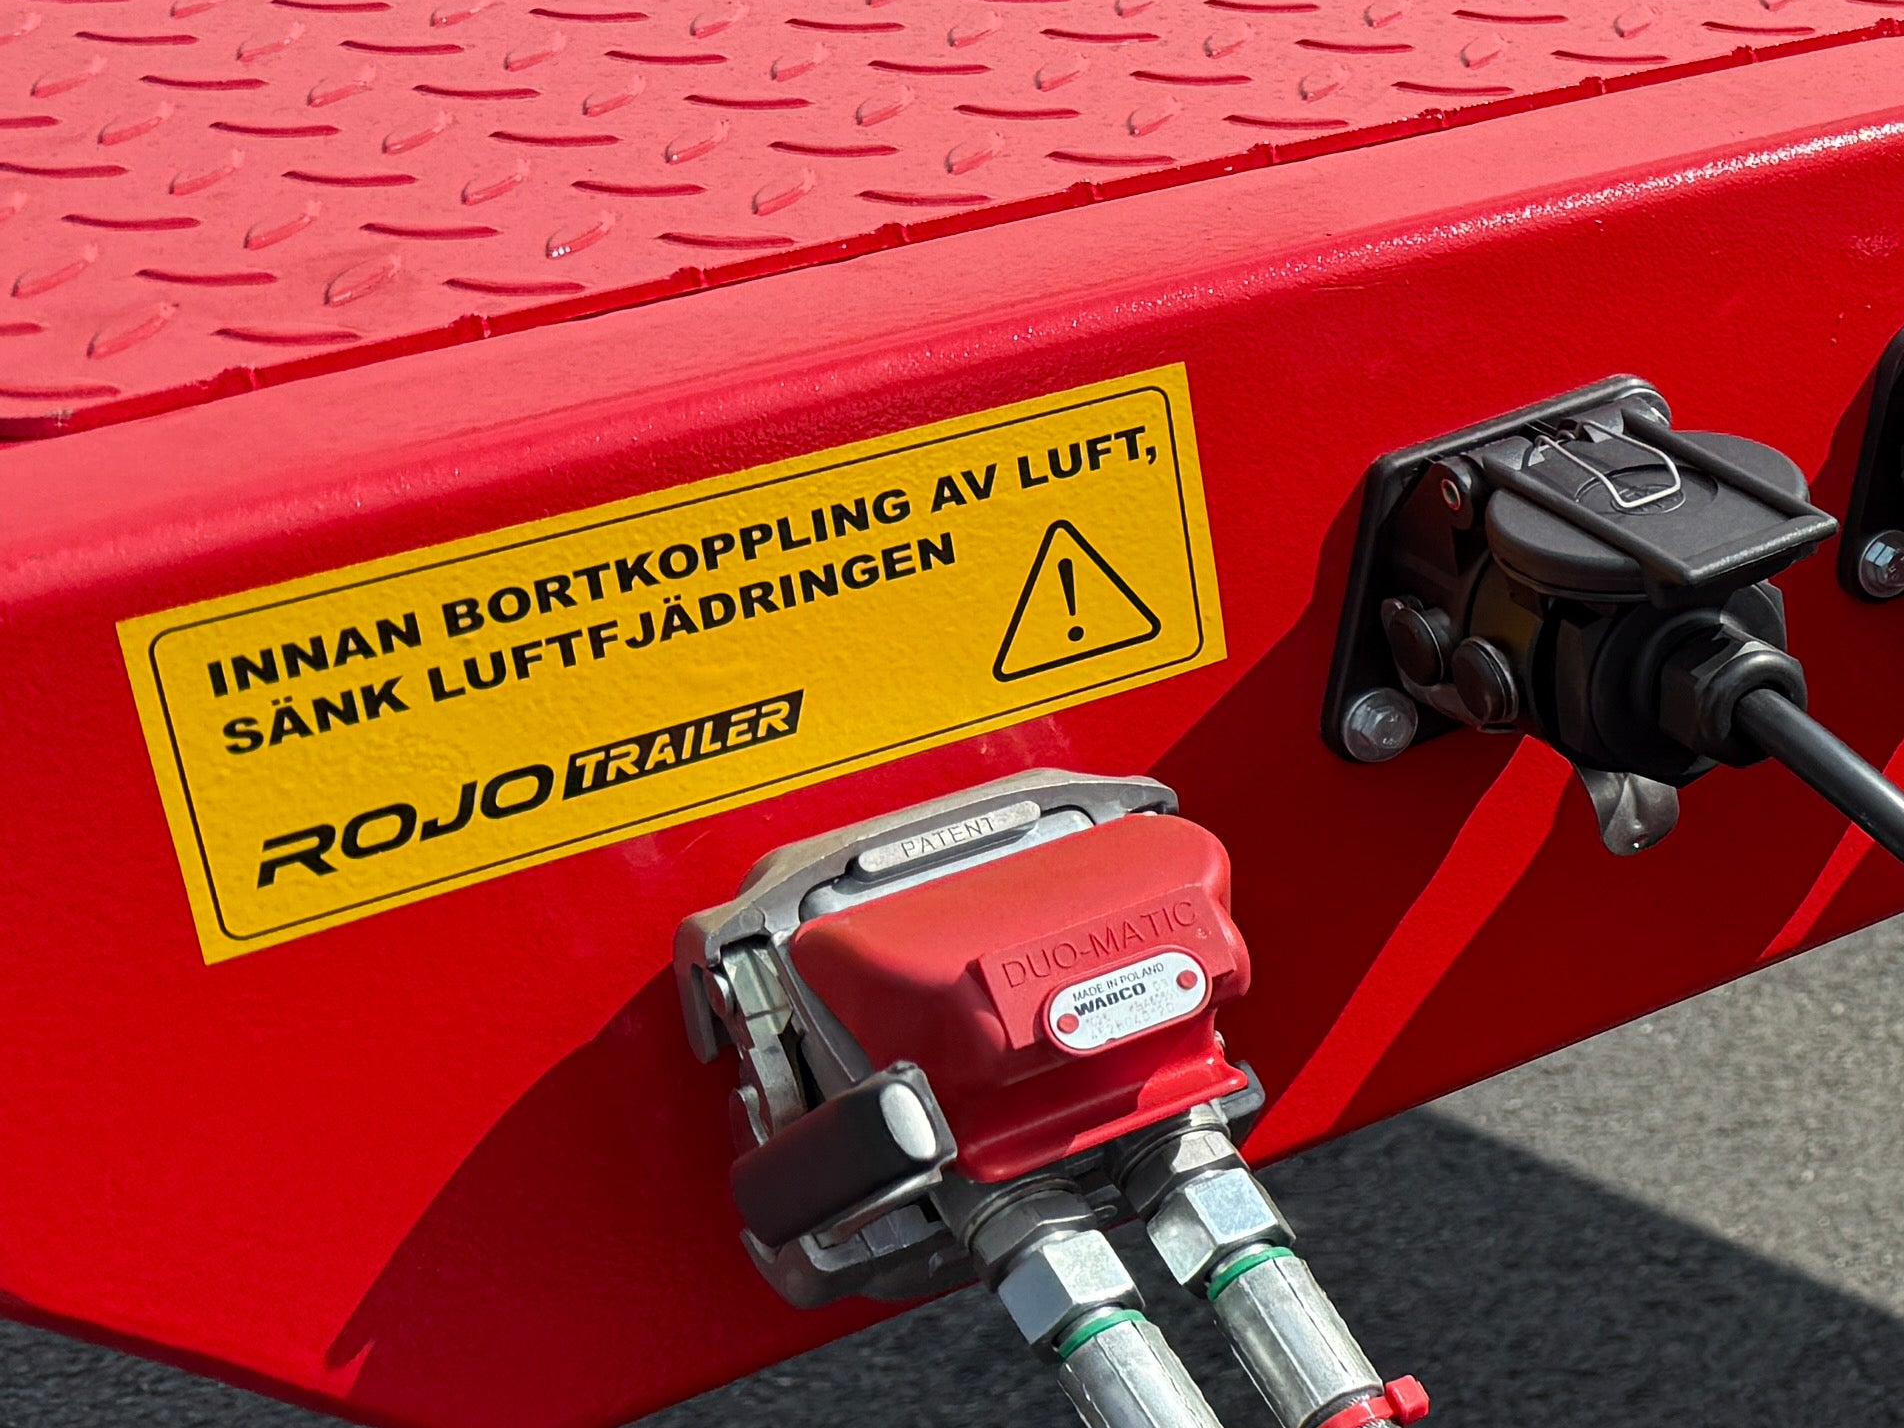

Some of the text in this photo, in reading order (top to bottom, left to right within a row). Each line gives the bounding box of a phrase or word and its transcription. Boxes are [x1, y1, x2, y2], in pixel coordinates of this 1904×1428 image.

[205, 425, 1160, 698] INNAN BORTKOPPLING AV LUFT,
[221, 531, 957, 757] SÄNK LUFTFJÄDRINGEN
[256, 698, 795, 889] ROJO TRAILER
[900, 817, 997, 860] PATENT
[1001, 900, 1198, 990] DUO-MATIC
[1072, 985, 1105, 1002] MADE
[1107, 979, 1118, 991] IN
[1120, 963, 1165, 985] POLAND
[1074, 982, 1146, 1016] WABCO
